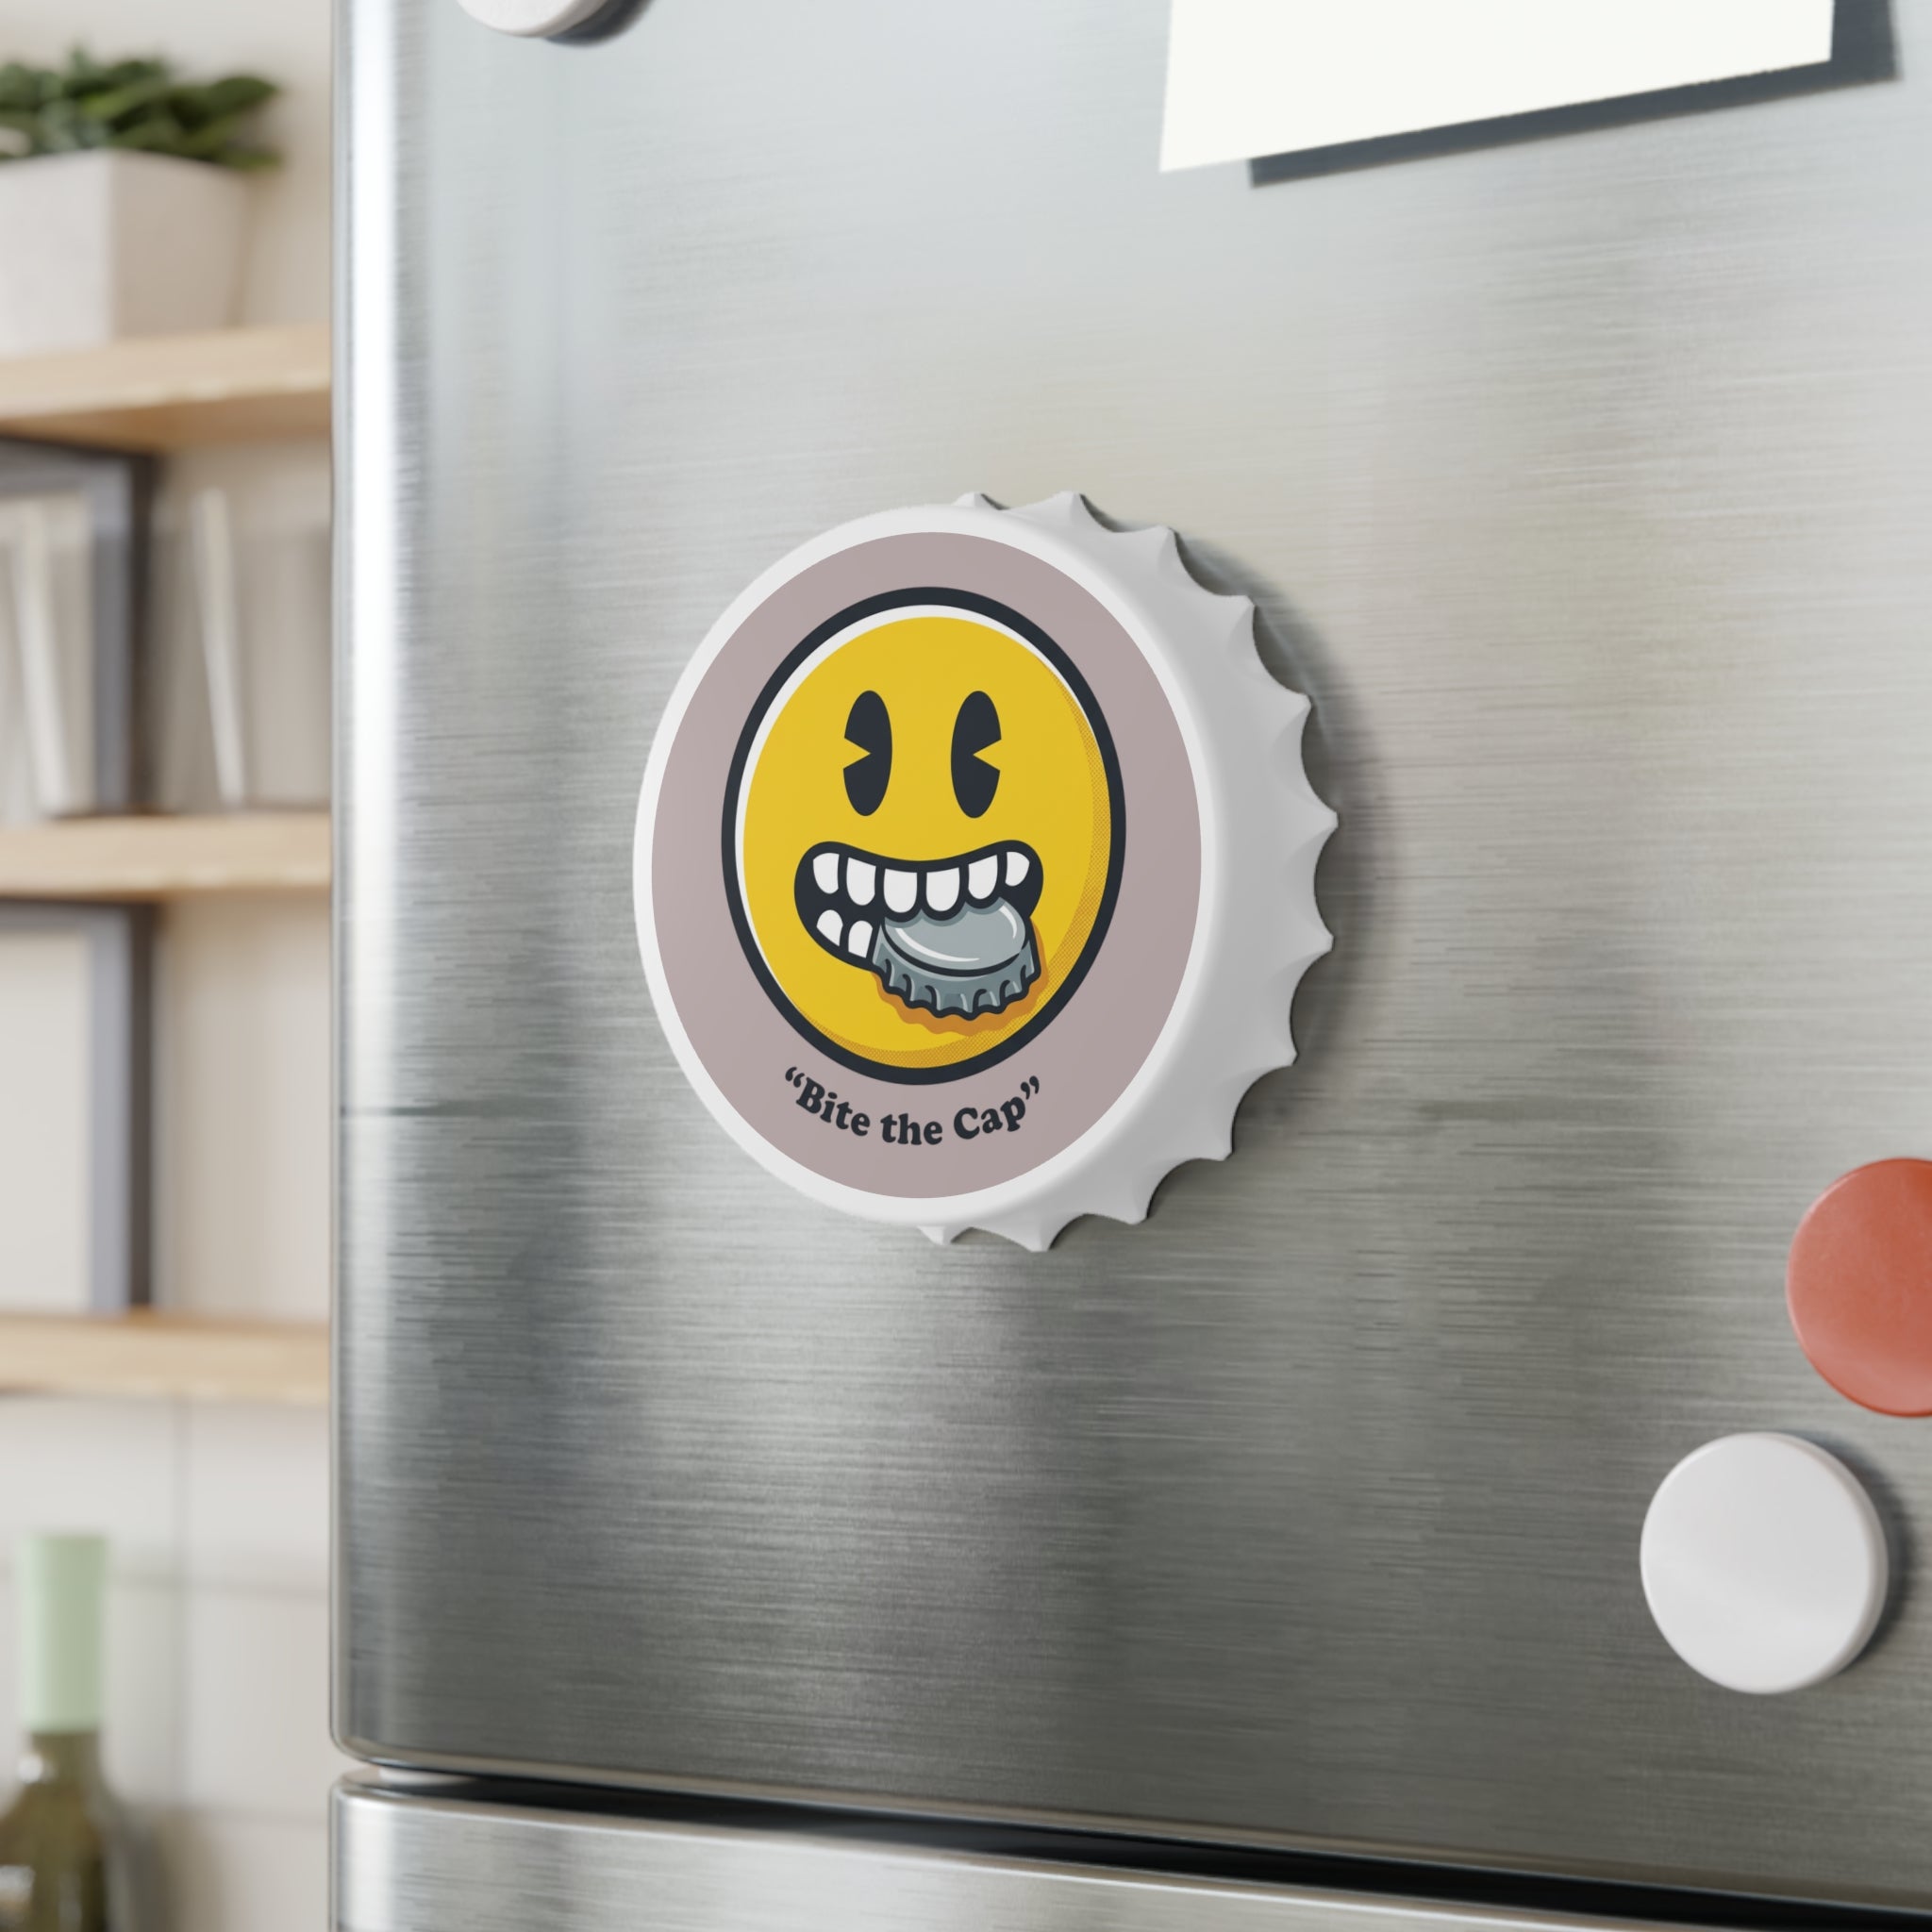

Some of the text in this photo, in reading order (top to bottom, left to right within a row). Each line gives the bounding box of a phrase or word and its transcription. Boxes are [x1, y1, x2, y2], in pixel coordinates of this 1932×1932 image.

[784, 1066, 1041, 1146] “Bite the Cap”
